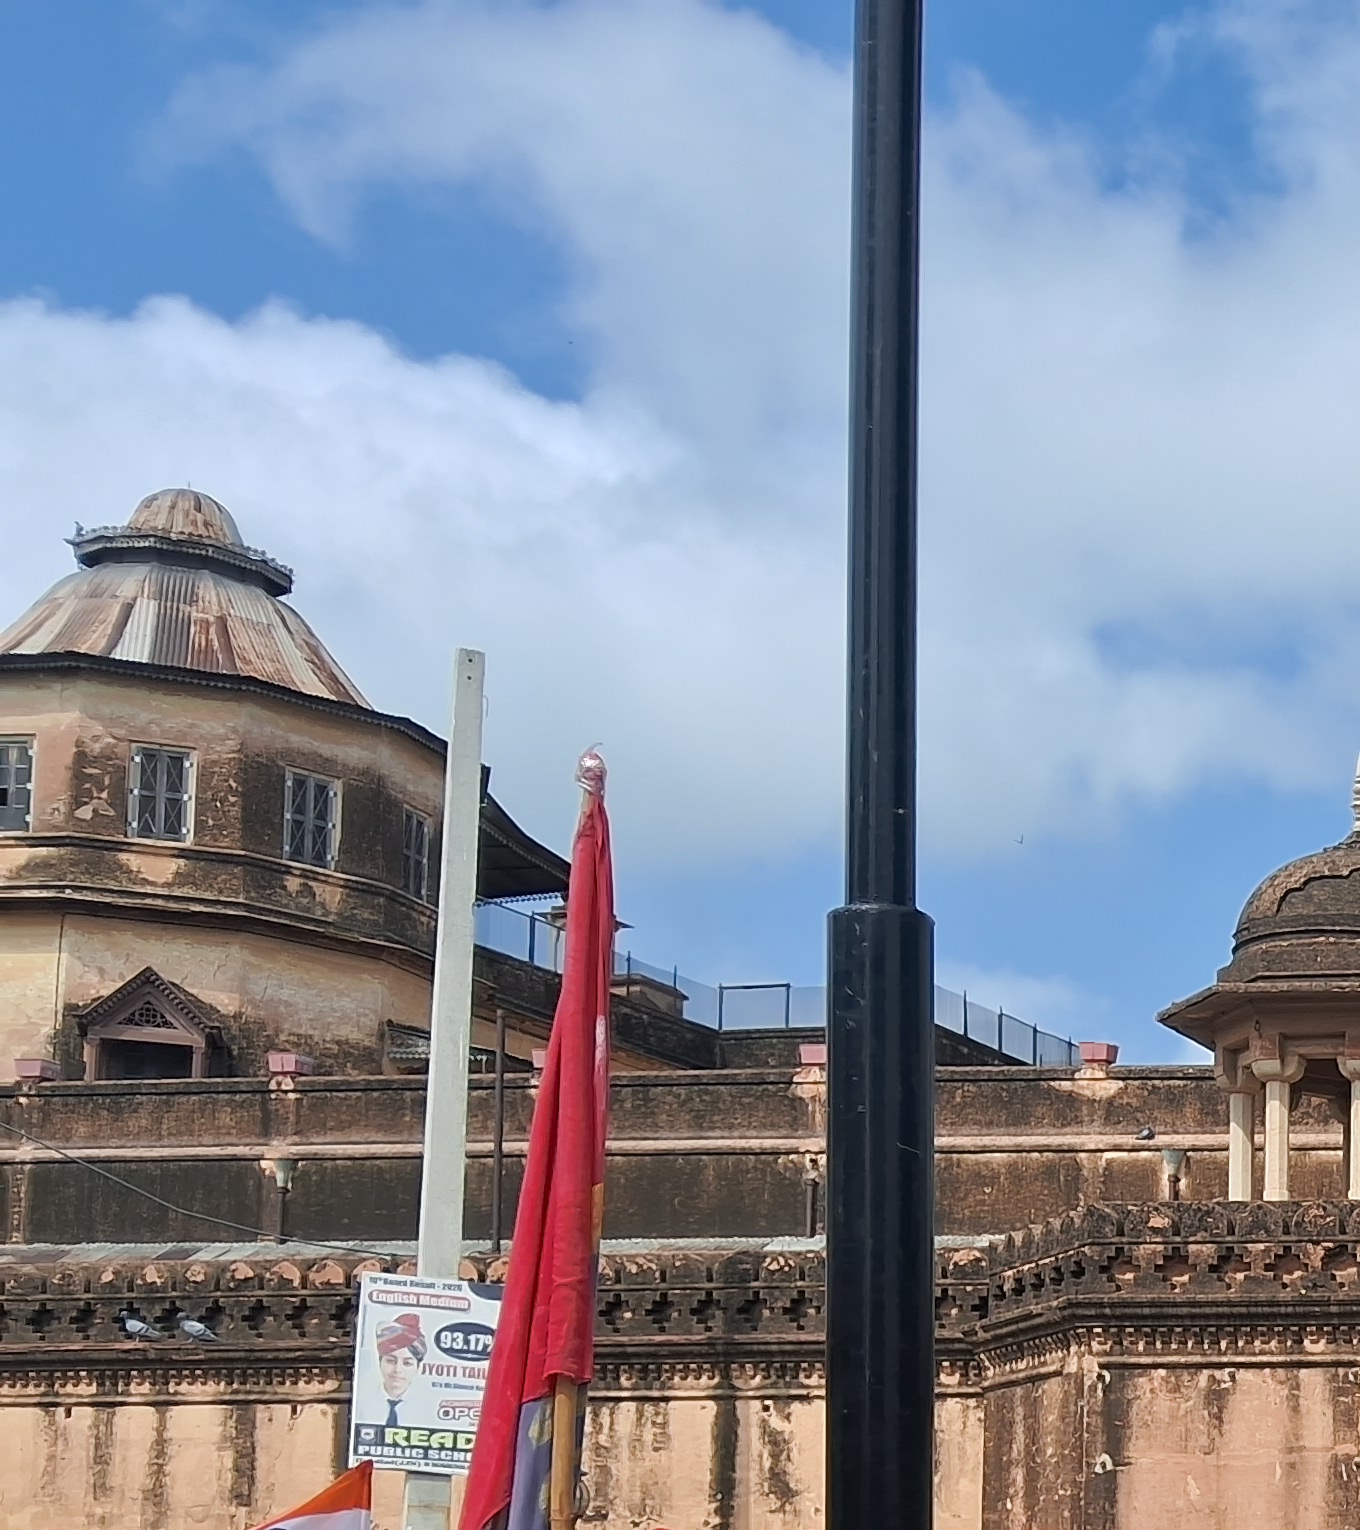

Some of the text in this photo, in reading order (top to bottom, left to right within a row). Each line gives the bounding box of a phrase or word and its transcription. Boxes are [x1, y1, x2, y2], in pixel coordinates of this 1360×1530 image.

[372, 1290, 469, 1309] English Medium
[421, 1362, 487, 1380] JYOTI TAIL
[437, 1405, 482, 1421] OPE
[383, 1426, 476, 1450] READ
[357, 1445, 472, 1462] PUBLIC SCH
